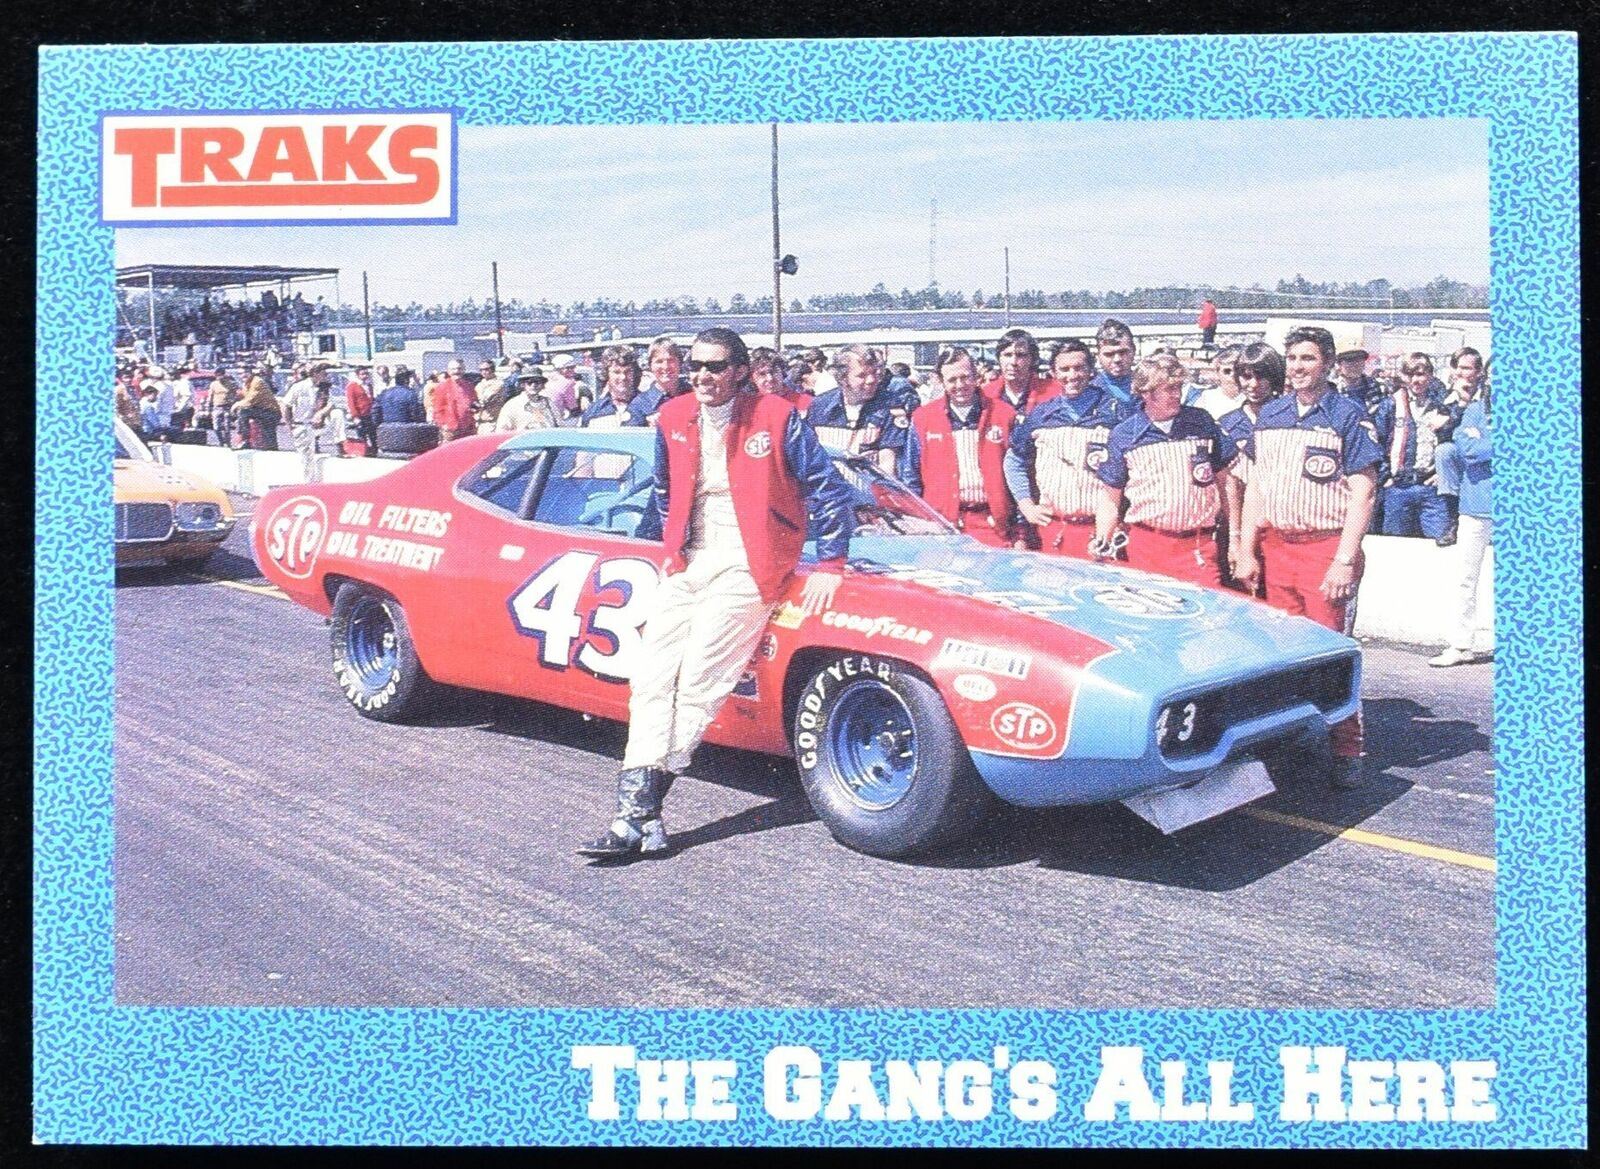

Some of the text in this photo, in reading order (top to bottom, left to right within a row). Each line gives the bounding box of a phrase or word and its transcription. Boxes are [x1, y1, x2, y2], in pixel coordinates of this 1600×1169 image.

[115, 127, 440, 207] TRAKS
[270, 504, 322, 568] STP
[326, 531, 445, 571] OIL TREATMENT
[339, 500, 452, 538] OIL FILTERS
[506, 550, 661, 684] 43
[822, 611, 933, 645] GOODYEAR
[799, 657, 891, 769] GOODYEAR
[999, 708, 1047, 739] STP
[572, 1046, 1497, 1122] THE GANG'S ALL HERE
